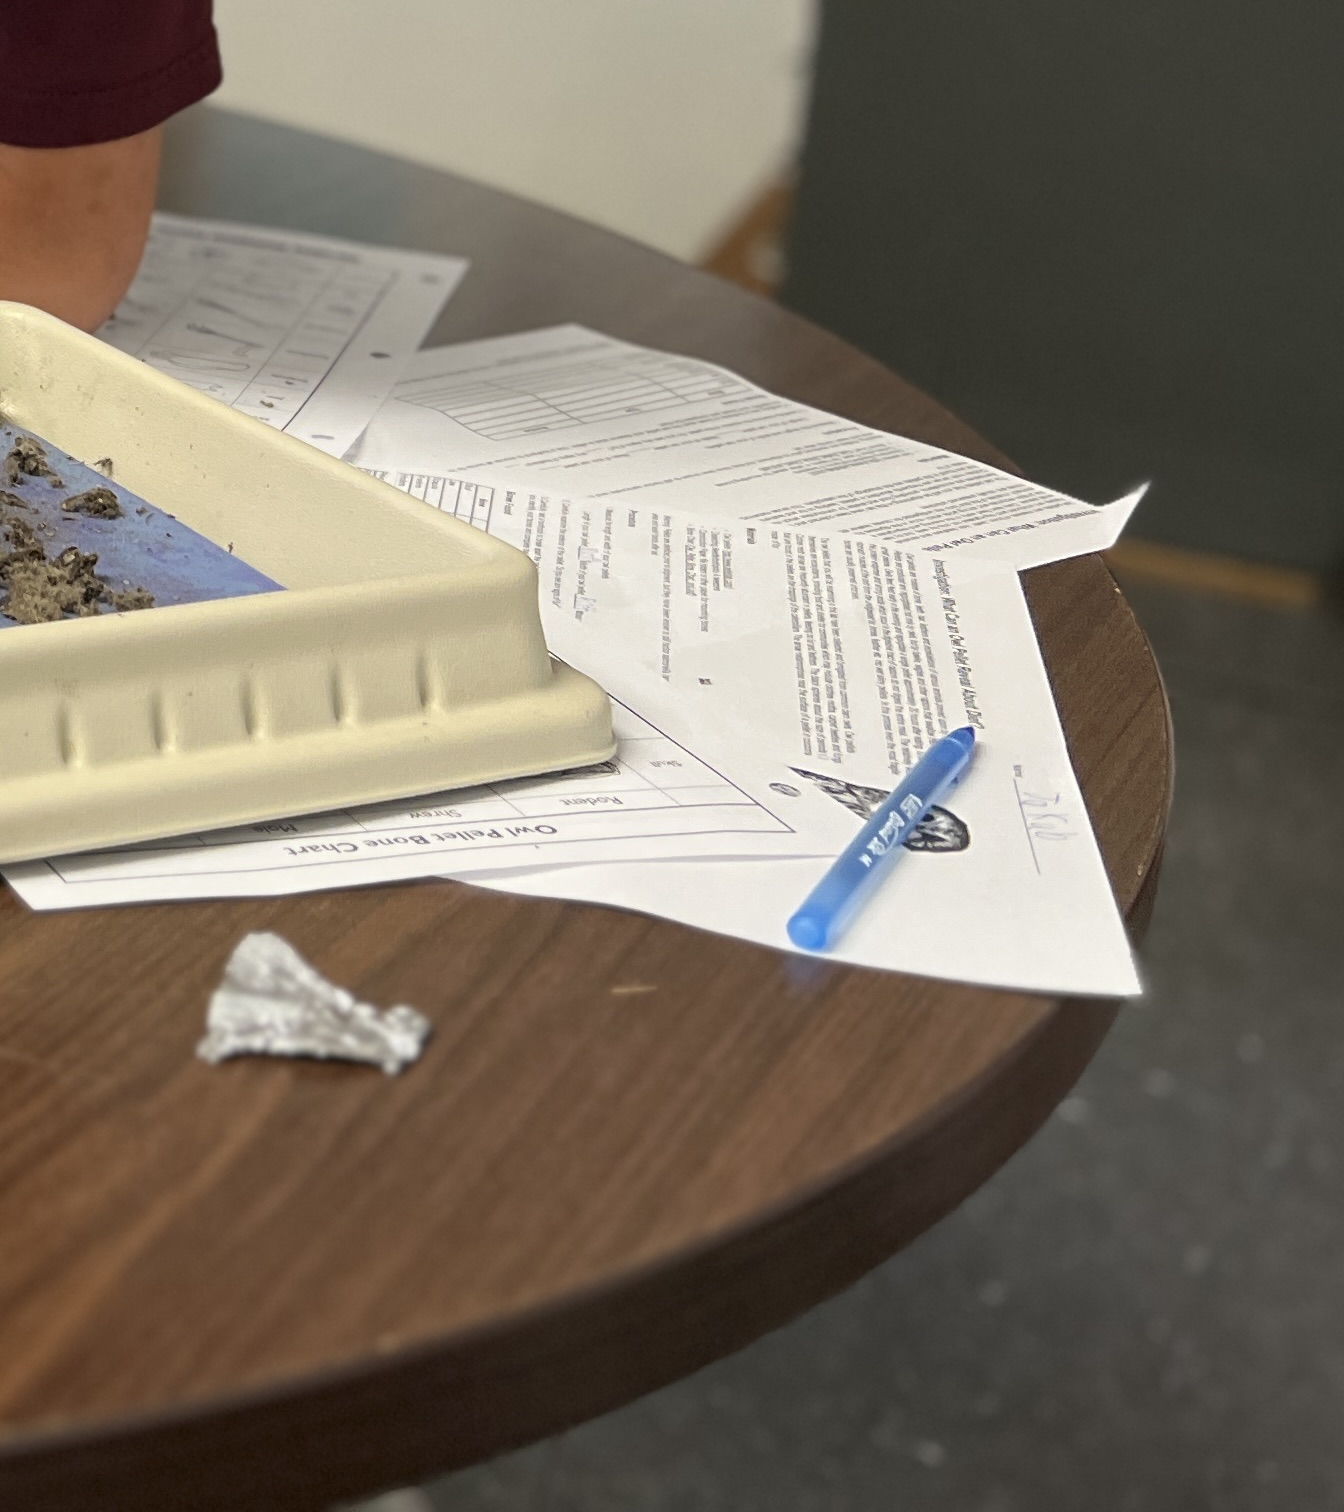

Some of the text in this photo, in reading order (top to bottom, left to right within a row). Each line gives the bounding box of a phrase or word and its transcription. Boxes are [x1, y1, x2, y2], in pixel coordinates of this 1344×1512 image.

[945, 613, 960, 625] Can
[950, 634, 964, 647] Owl
[953, 647, 968, 665] Pellet
[958, 665, 974, 688] Reveal
[963, 689, 979, 710] About
[559, 795, 624, 807] Rodent
[409, 808, 462, 819] Shrew
[283, 824, 558, 857] Owl Pellet Bone Chart
